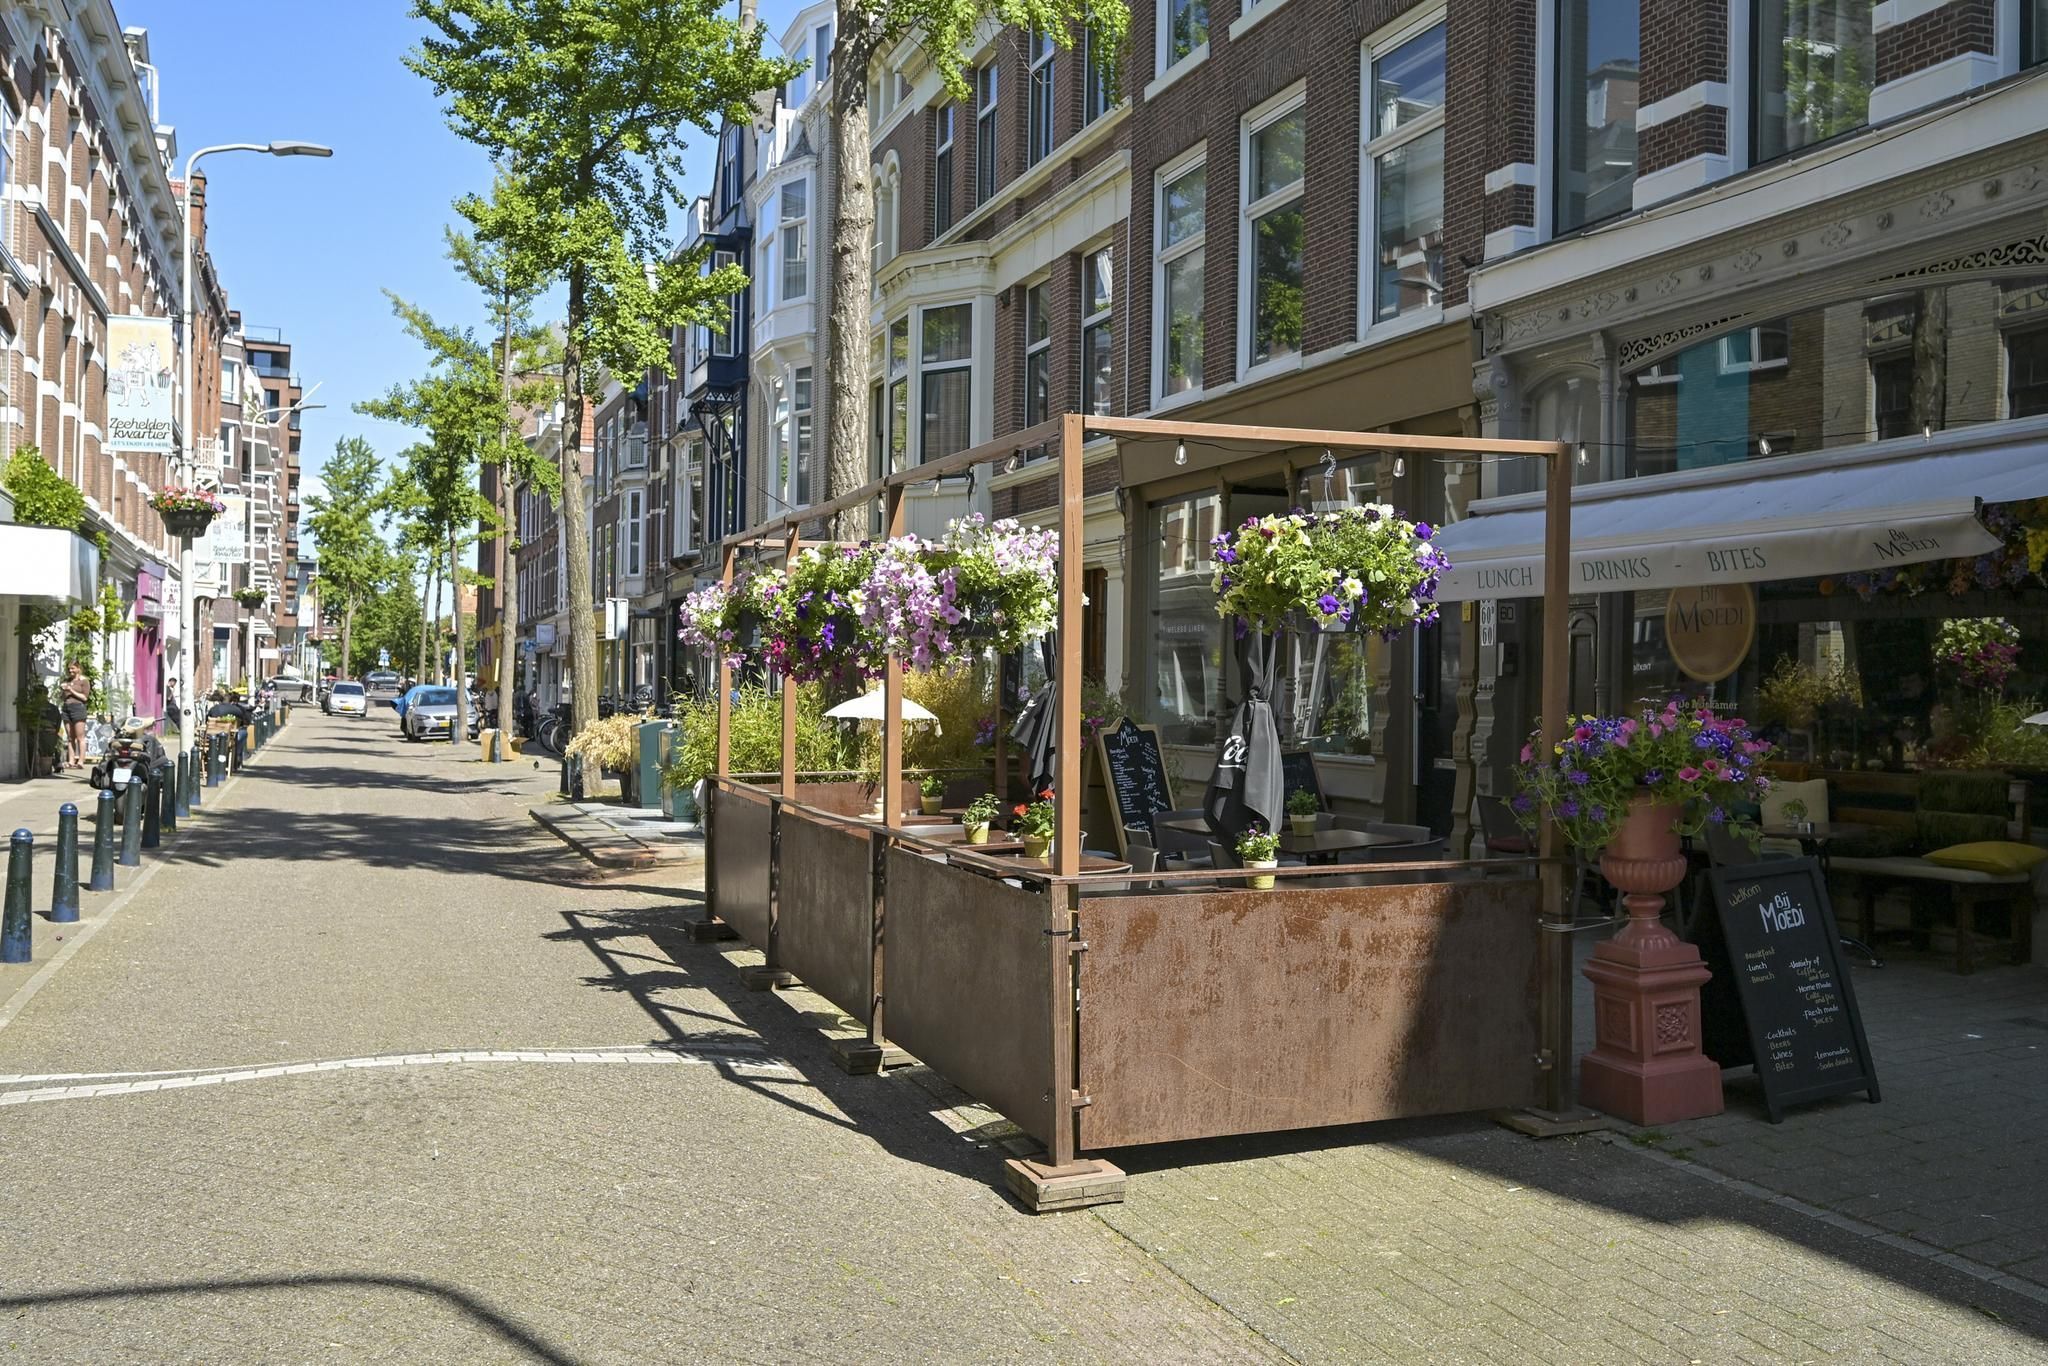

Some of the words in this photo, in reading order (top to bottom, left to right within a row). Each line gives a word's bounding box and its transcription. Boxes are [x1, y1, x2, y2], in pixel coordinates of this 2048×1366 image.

[110, 418, 170, 430] Zeehelden
[113, 427, 170, 440] kwartier
[1581, 557, 1651, 582] DRINKS
[1707, 546, 1767, 572] BITES
[1478, 566, 1534, 589] LUNCH
[1482, 627, 1492, 644] 60
[1774, 891, 1791, 910] Bij
